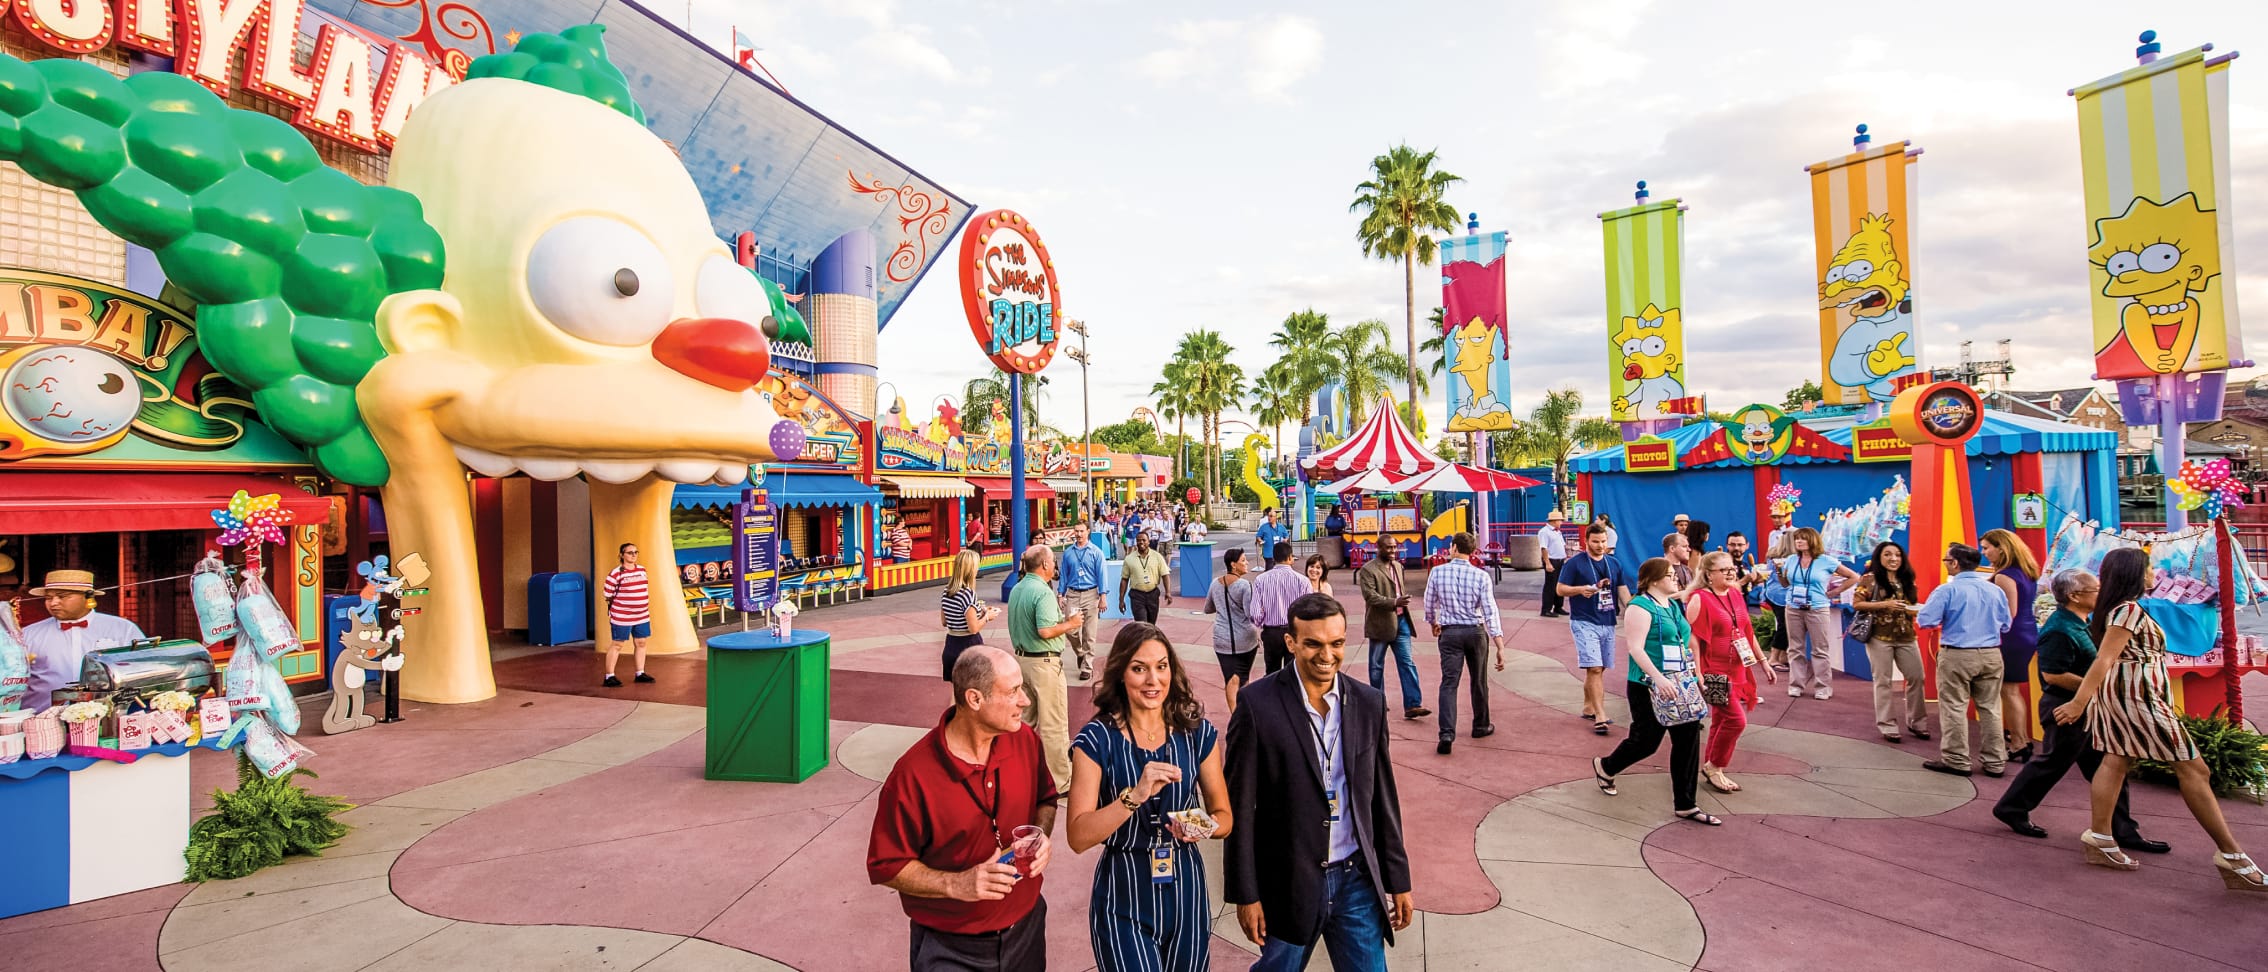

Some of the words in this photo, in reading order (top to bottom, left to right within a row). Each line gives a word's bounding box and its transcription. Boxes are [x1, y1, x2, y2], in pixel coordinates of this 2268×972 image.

[990, 298, 1055, 355] RIDE
[1921, 405, 1973, 418] UNIVERSAL
[882, 425, 943, 466] SIDESHOW
[944, 448, 964, 471] YOU
[1861, 437, 1912, 450] PHOTO
[799, 443, 835, 458] ELPER
[1631, 451, 1667, 462] PHOTOS
[228, 698, 242, 707] TTON
